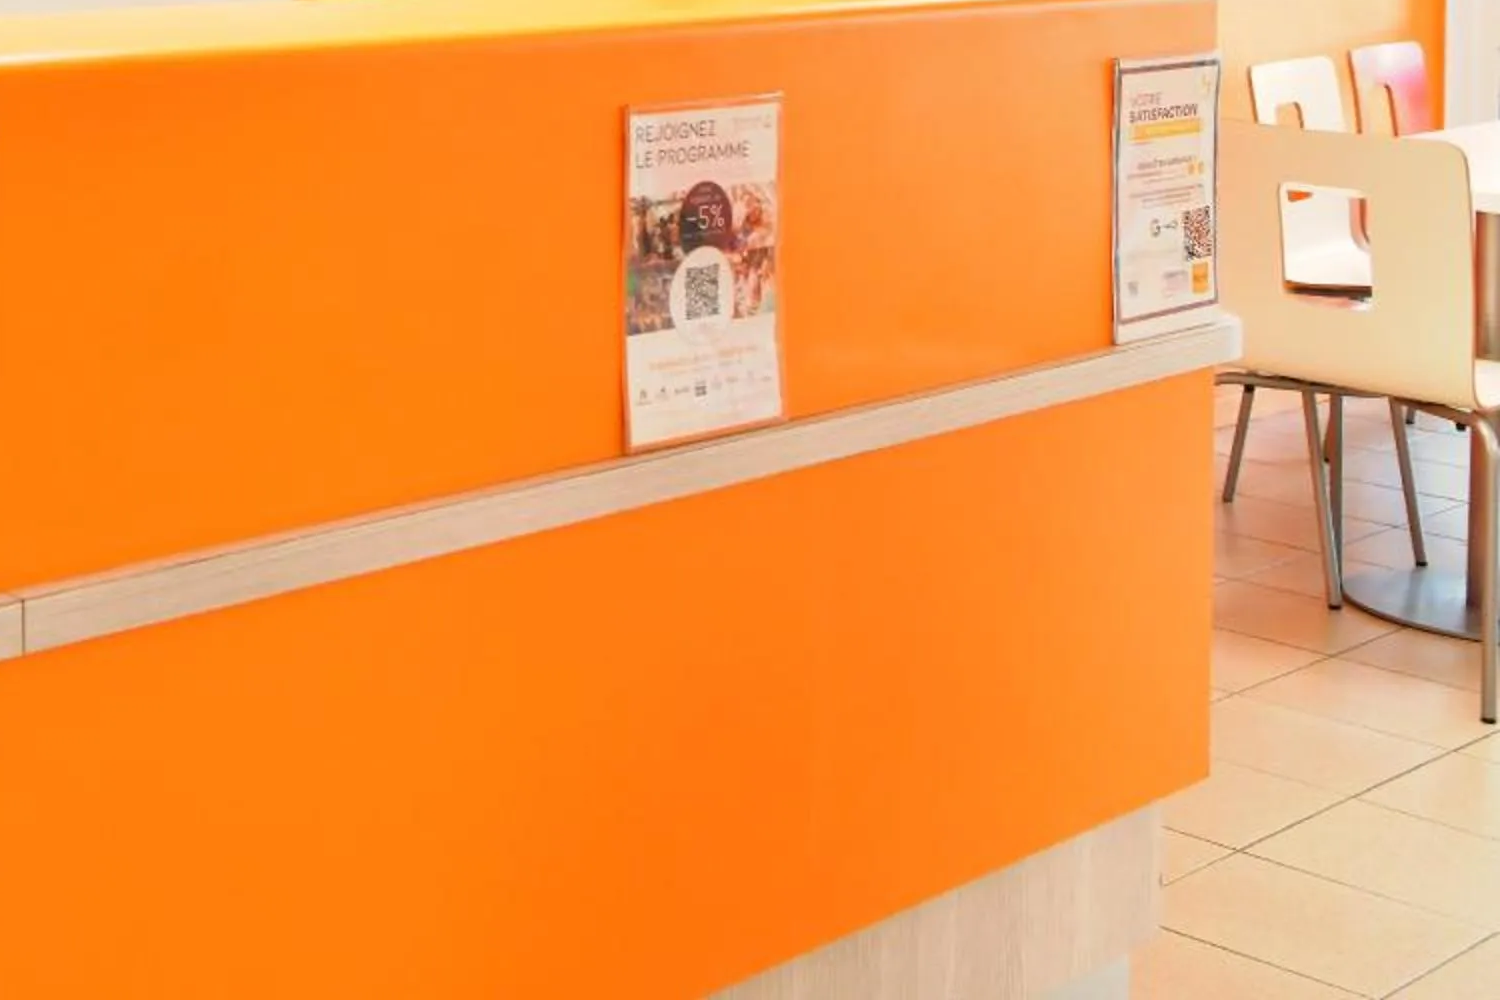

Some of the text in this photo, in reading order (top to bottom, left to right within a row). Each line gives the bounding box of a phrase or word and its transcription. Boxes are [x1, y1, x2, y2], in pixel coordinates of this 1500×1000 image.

[1129, 103, 1198, 124] SATISFACTION
[635, 120, 716, 143] REJOIGNEZ
[636, 140, 750, 169] LE PROGRAMME
